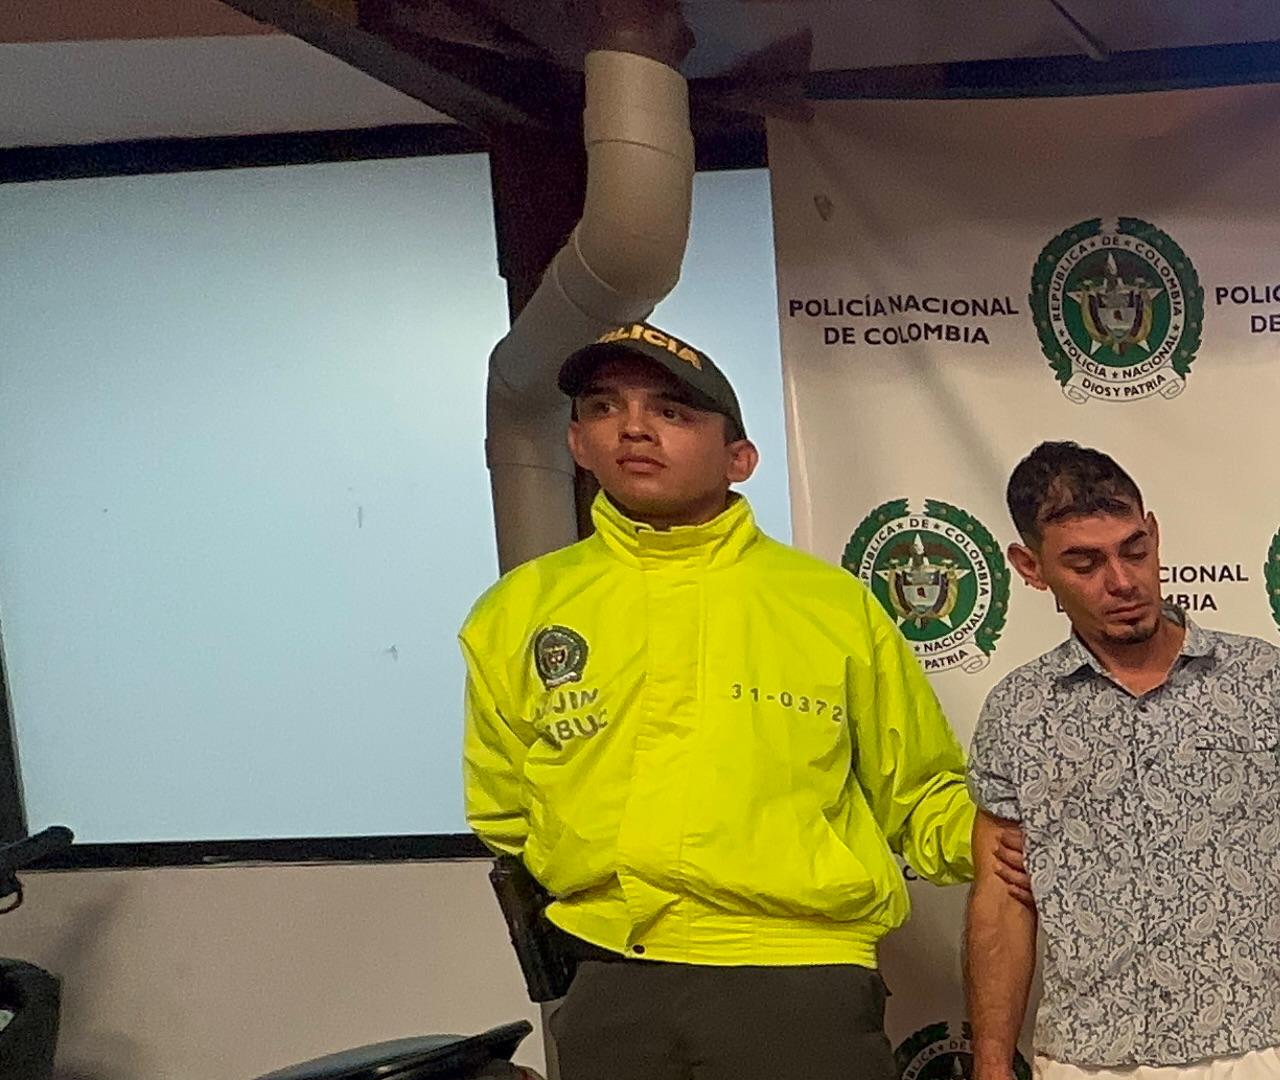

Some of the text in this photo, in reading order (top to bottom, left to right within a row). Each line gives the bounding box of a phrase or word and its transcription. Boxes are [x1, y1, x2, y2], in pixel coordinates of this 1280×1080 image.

[1053, 237, 1182, 322] REPUBLICA DE COLOMBIA
[789, 295, 1019, 317] POLICÍA NACIONAL
[825, 323, 989, 345] DE COLOMBIA
[1122, 330, 1179, 379] NACIONAL
[1082, 374, 1167, 397] DIOS PATRIA
[862, 518, 989, 596] PUBLICA DE COLOMBIA
[1160, 565, 1249, 583] CIONAL
[924, 613, 984, 652] NACIONAL
[925, 650, 968, 669] PATRIA
